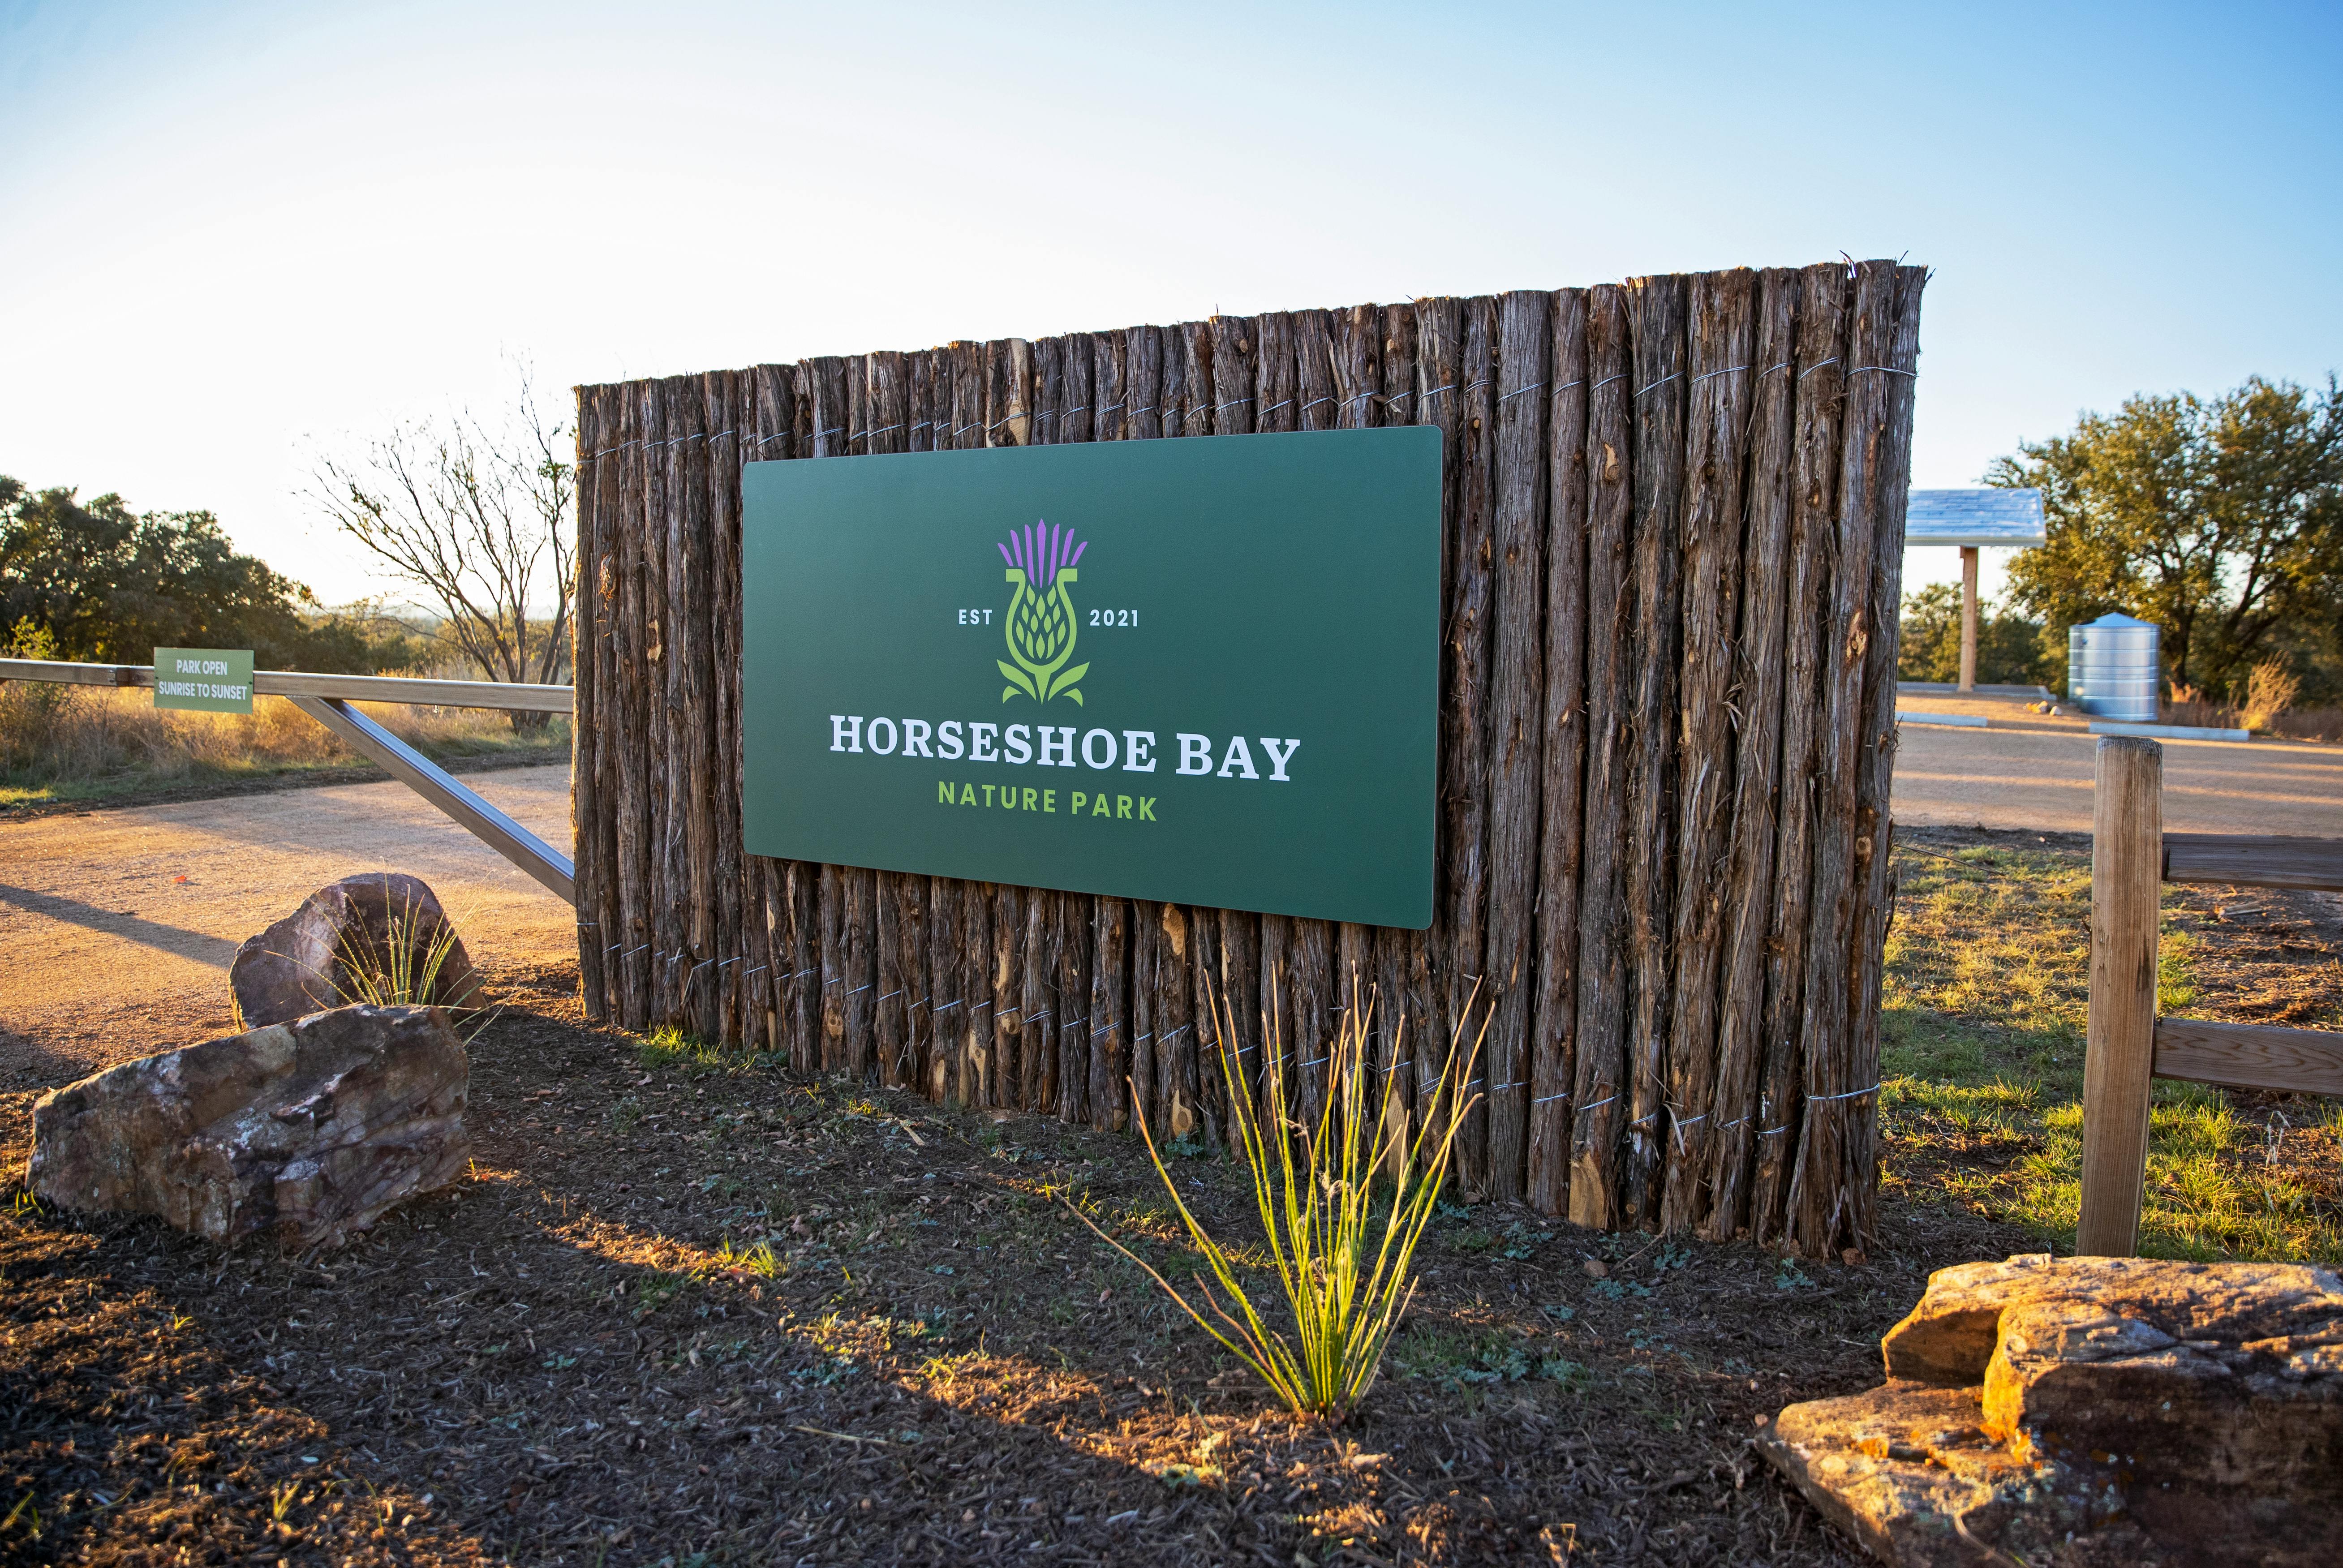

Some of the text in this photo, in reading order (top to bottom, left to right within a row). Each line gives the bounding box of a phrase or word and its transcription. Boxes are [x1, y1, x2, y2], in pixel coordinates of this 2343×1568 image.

[959, 609, 1137, 627] EST 2021
[176, 659, 228, 675] PARK OPEN
[159, 681, 247, 700] SUNRISE TO SUNSET
[830, 715, 1301, 782] HORSESHOE BAY
[939, 781, 1157, 822] NATURE PARK
